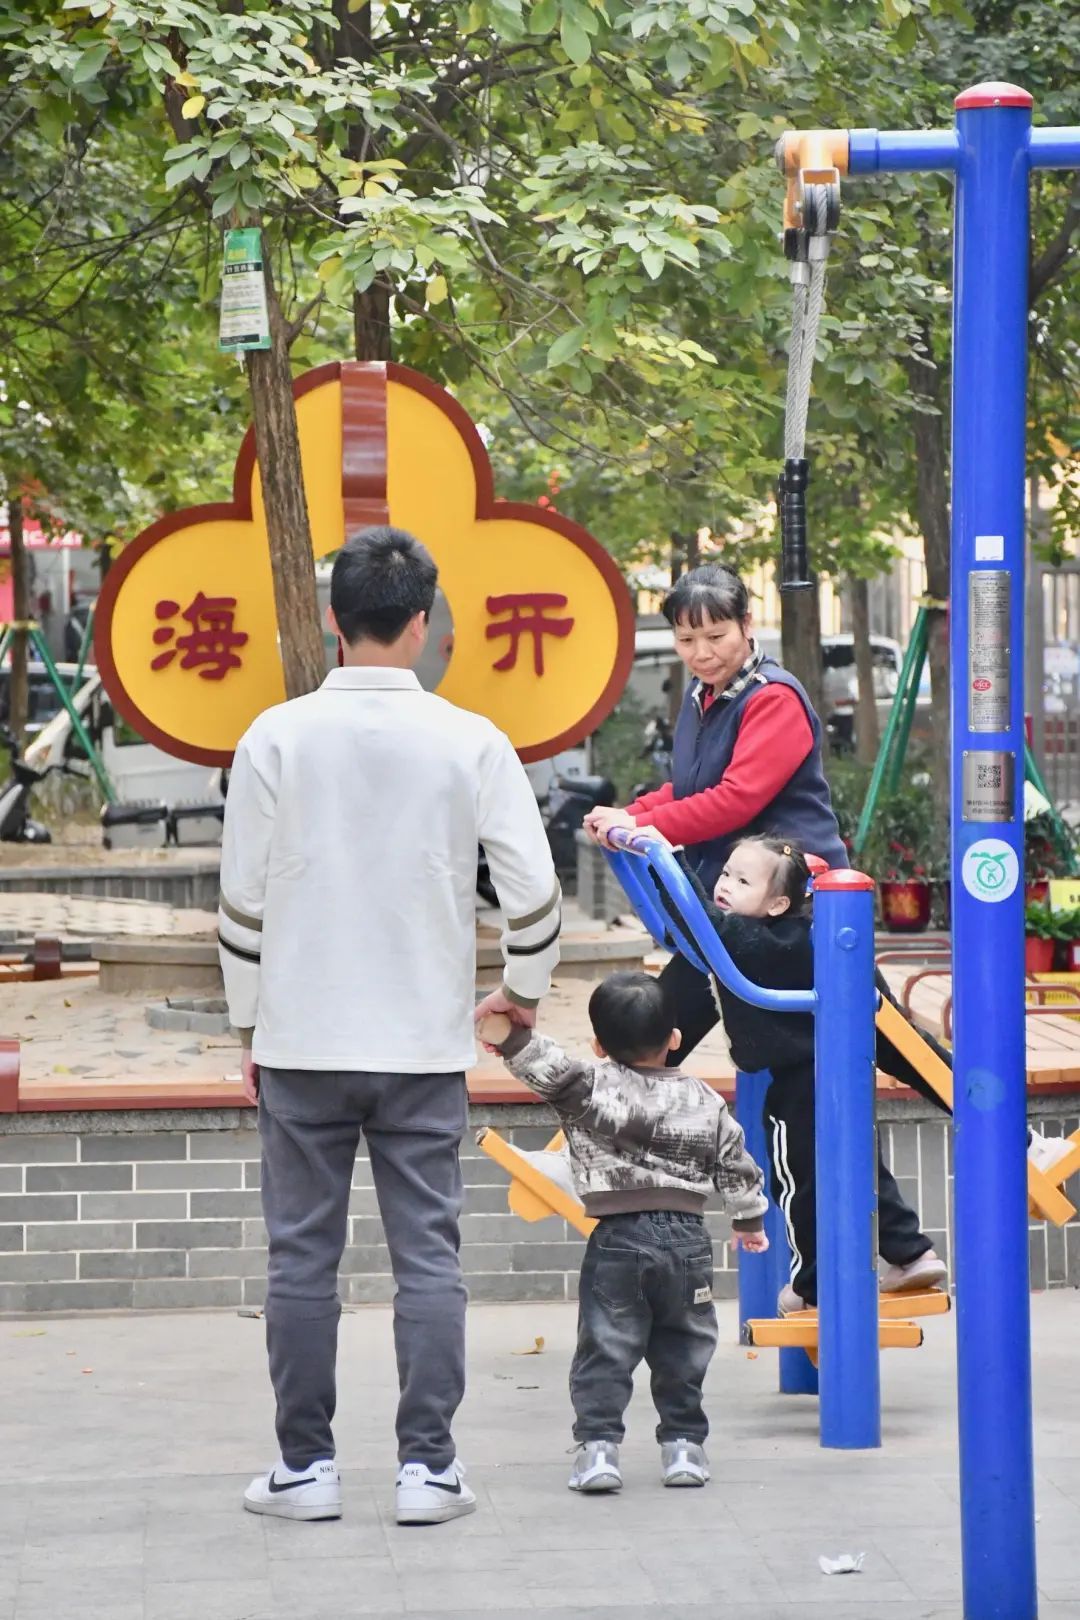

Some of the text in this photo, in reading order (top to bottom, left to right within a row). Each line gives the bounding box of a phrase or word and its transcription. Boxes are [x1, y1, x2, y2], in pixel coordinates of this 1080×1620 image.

[151, 590, 249, 681] 海
[485, 592, 574, 678] 开
[319, 1465, 335, 1474] NIKE
[404, 1469, 420, 1477] NIKE
